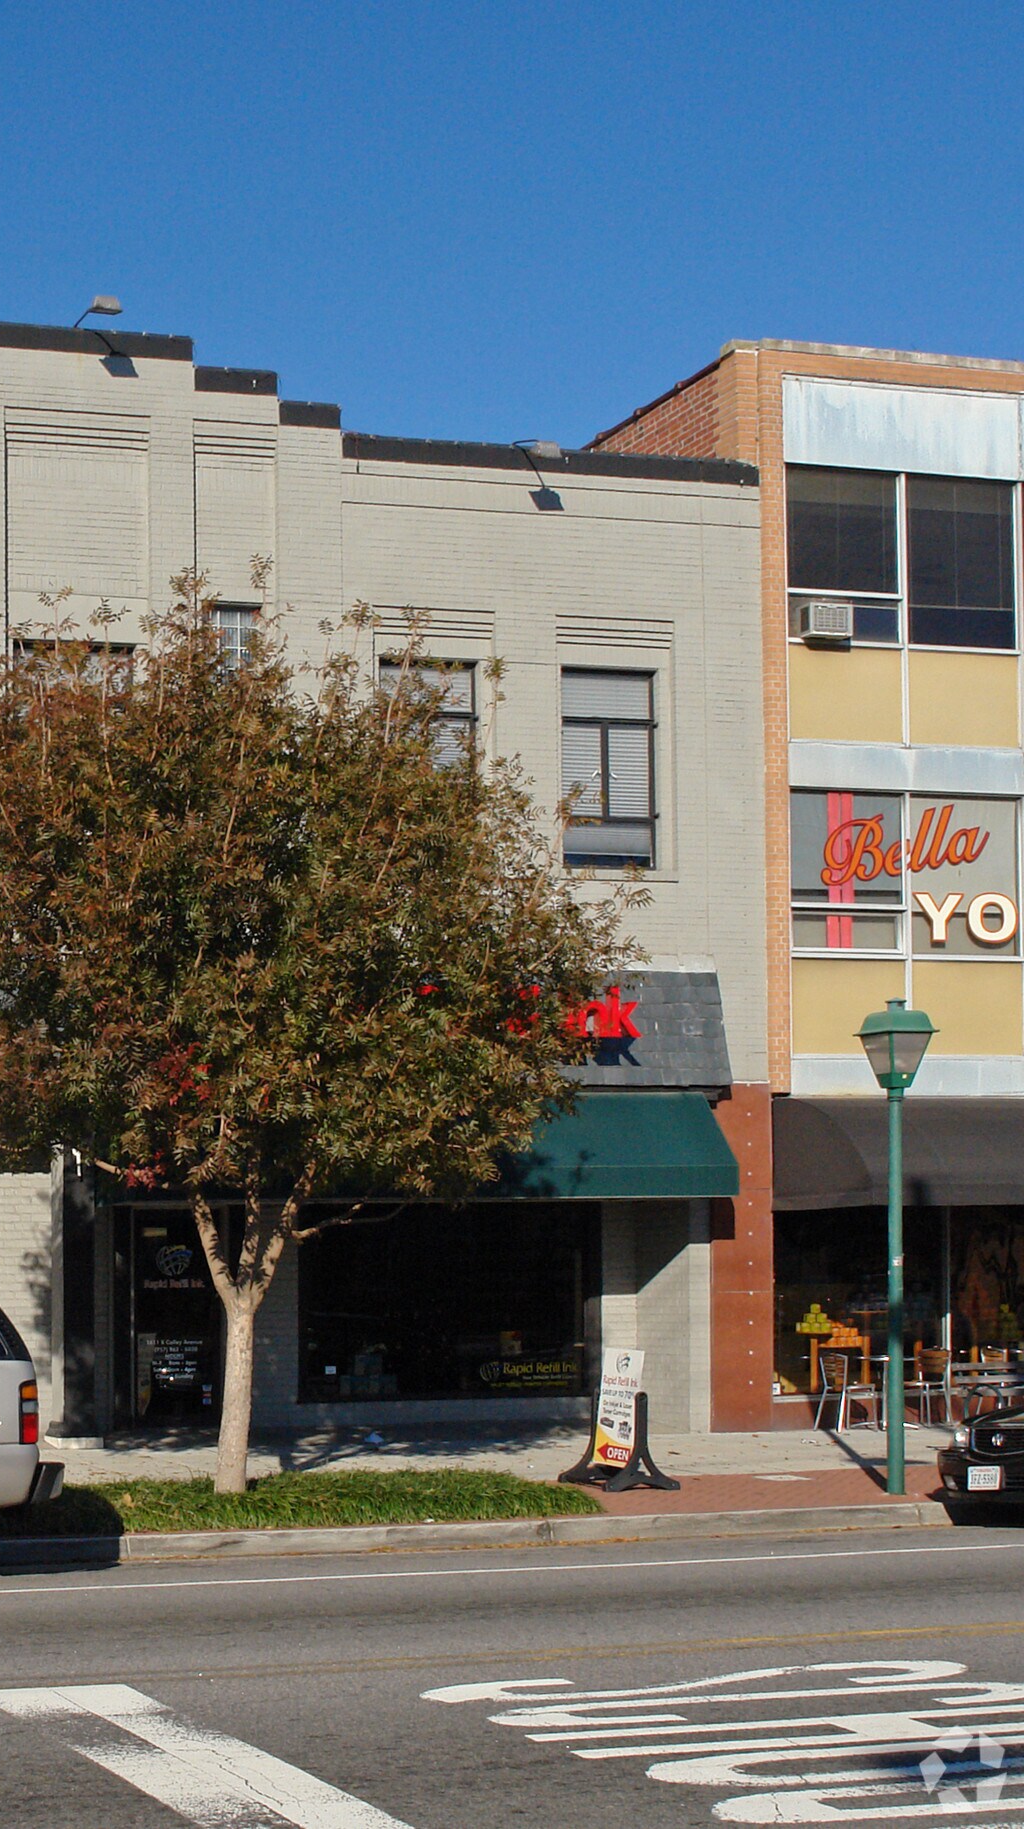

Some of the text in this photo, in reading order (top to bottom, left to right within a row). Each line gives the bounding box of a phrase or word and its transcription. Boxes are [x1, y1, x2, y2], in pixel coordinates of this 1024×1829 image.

[821, 804, 990, 886] Bella
[912, 891, 1018, 944] YO
[503, 1362, 533, 1375] Rapid
[537, 1362, 560, 1373] Refill
[606, 1446, 629, 1461] OPEN
